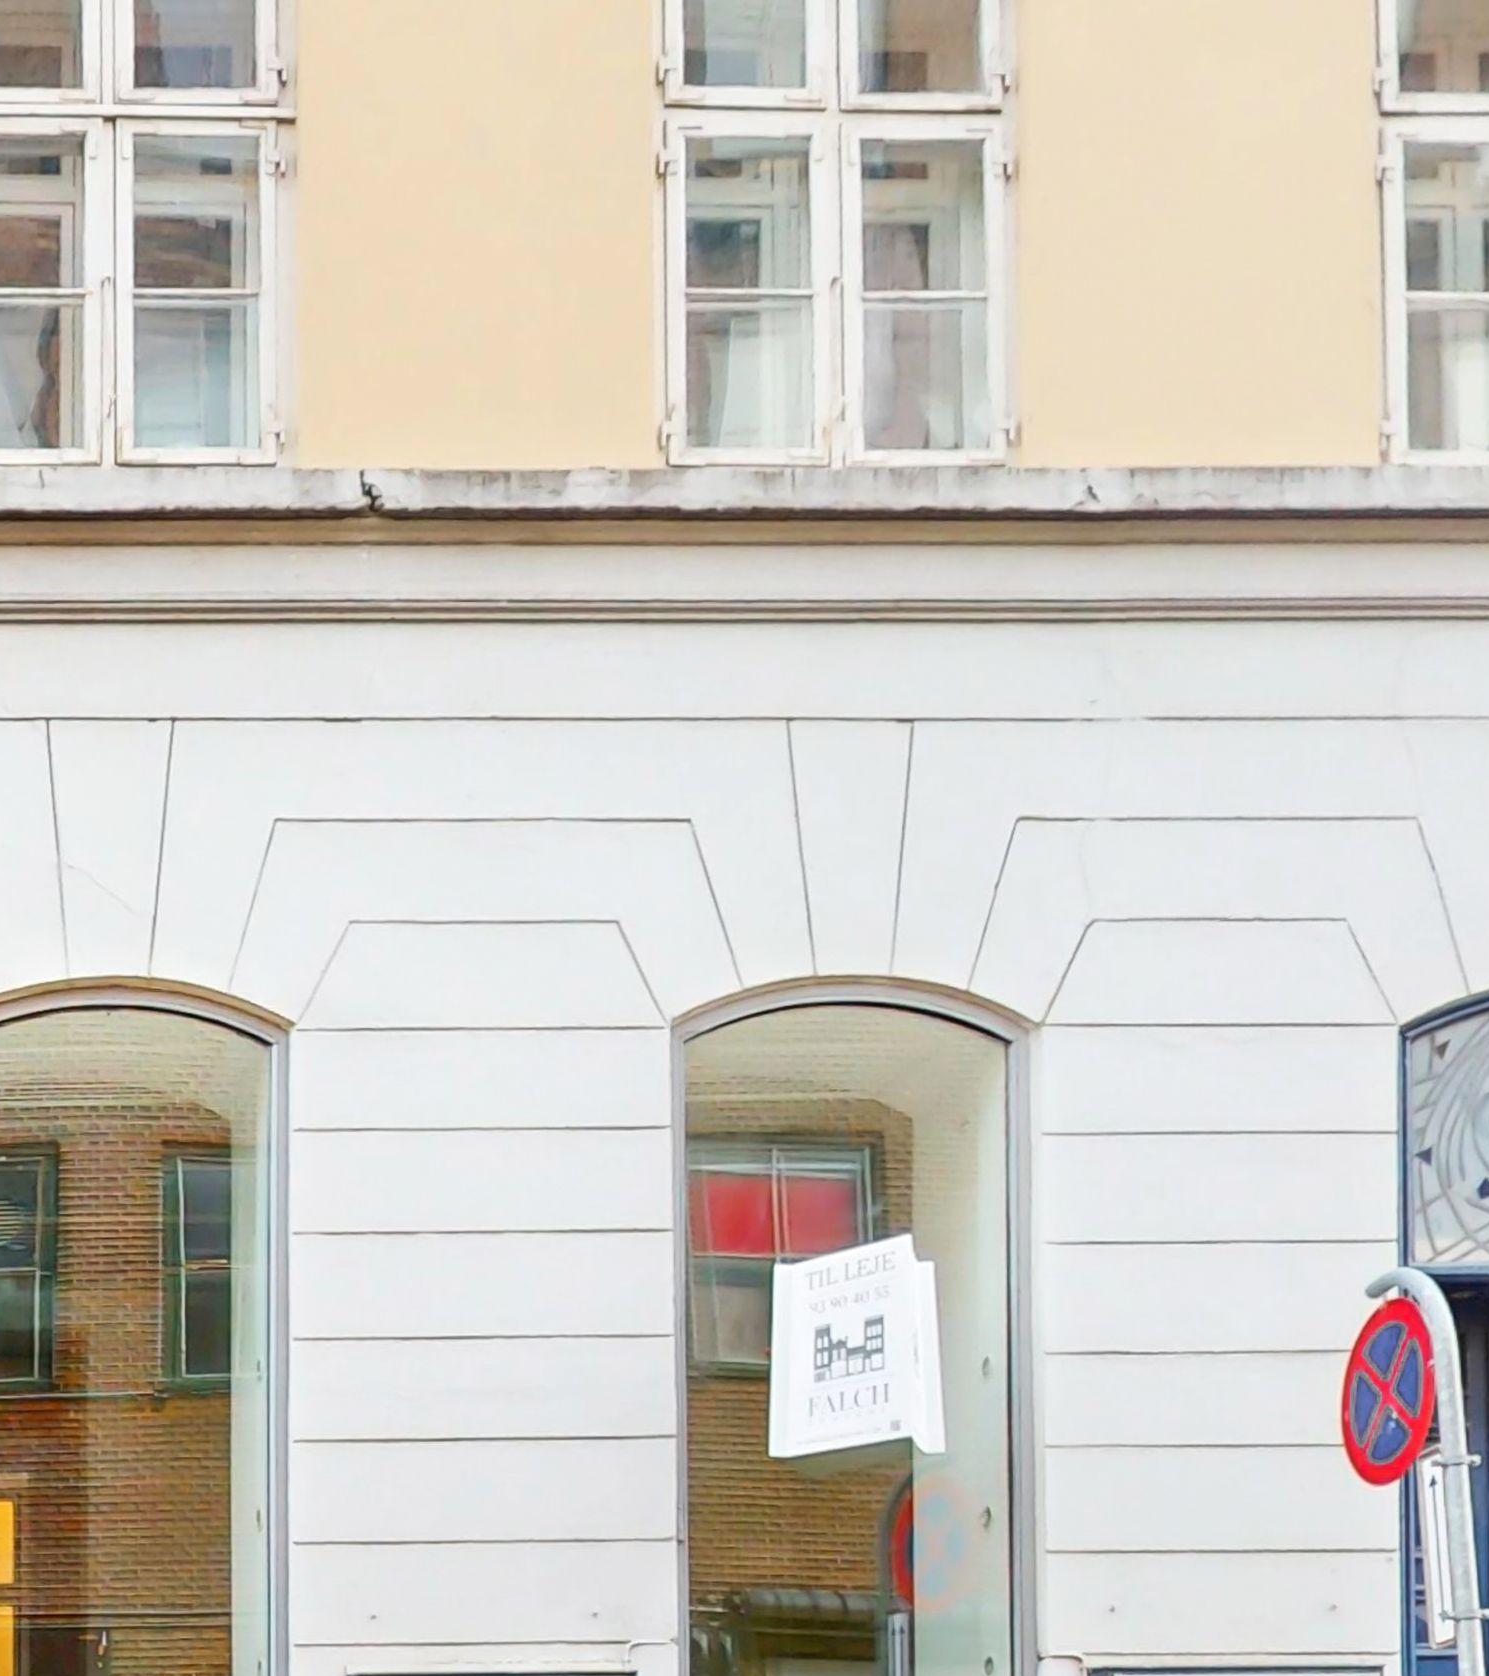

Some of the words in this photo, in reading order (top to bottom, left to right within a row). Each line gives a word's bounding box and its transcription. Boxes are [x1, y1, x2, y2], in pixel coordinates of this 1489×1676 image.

[805, 1266, 839, 1290] TIL
[844, 1251, 896, 1281] LEJE
[808, 1383, 889, 1417] FALCH
